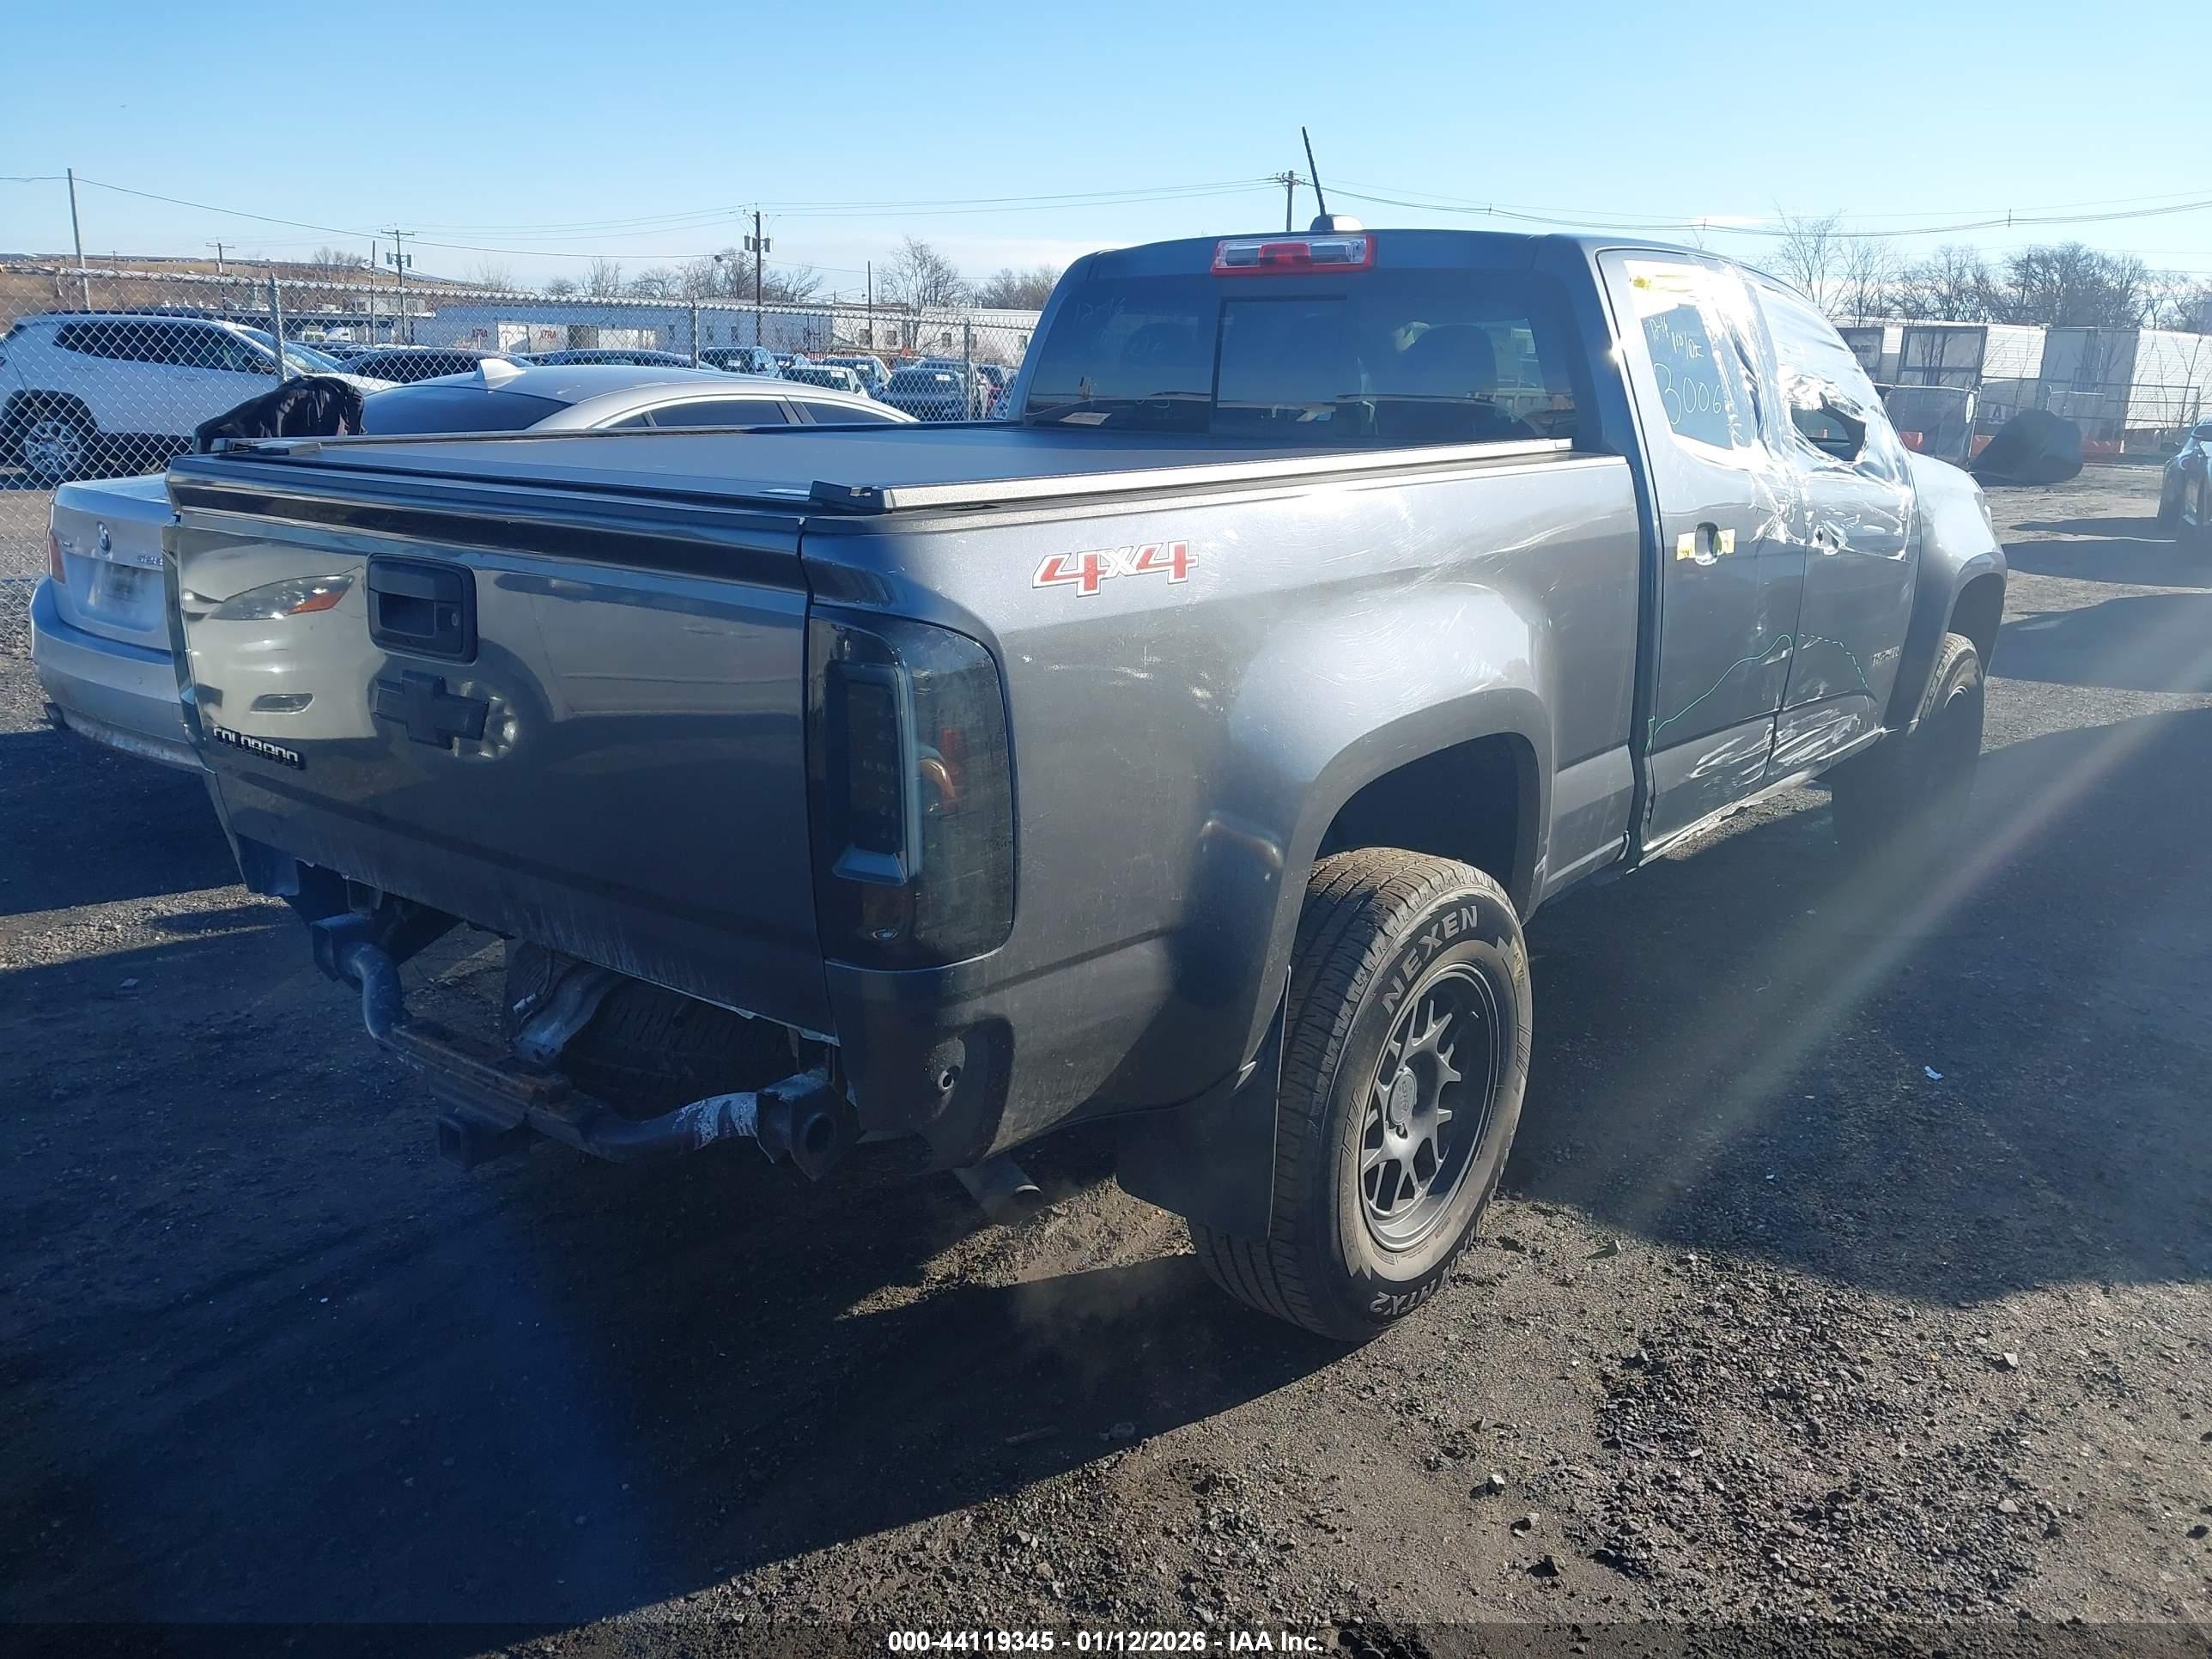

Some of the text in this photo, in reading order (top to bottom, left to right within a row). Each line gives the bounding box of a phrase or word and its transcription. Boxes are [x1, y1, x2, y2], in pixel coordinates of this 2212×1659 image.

[539, 330, 557, 339] XTRA
[1653, 362, 1722, 425] 3006
[1382, 905, 1478, 1017] NEXEN
